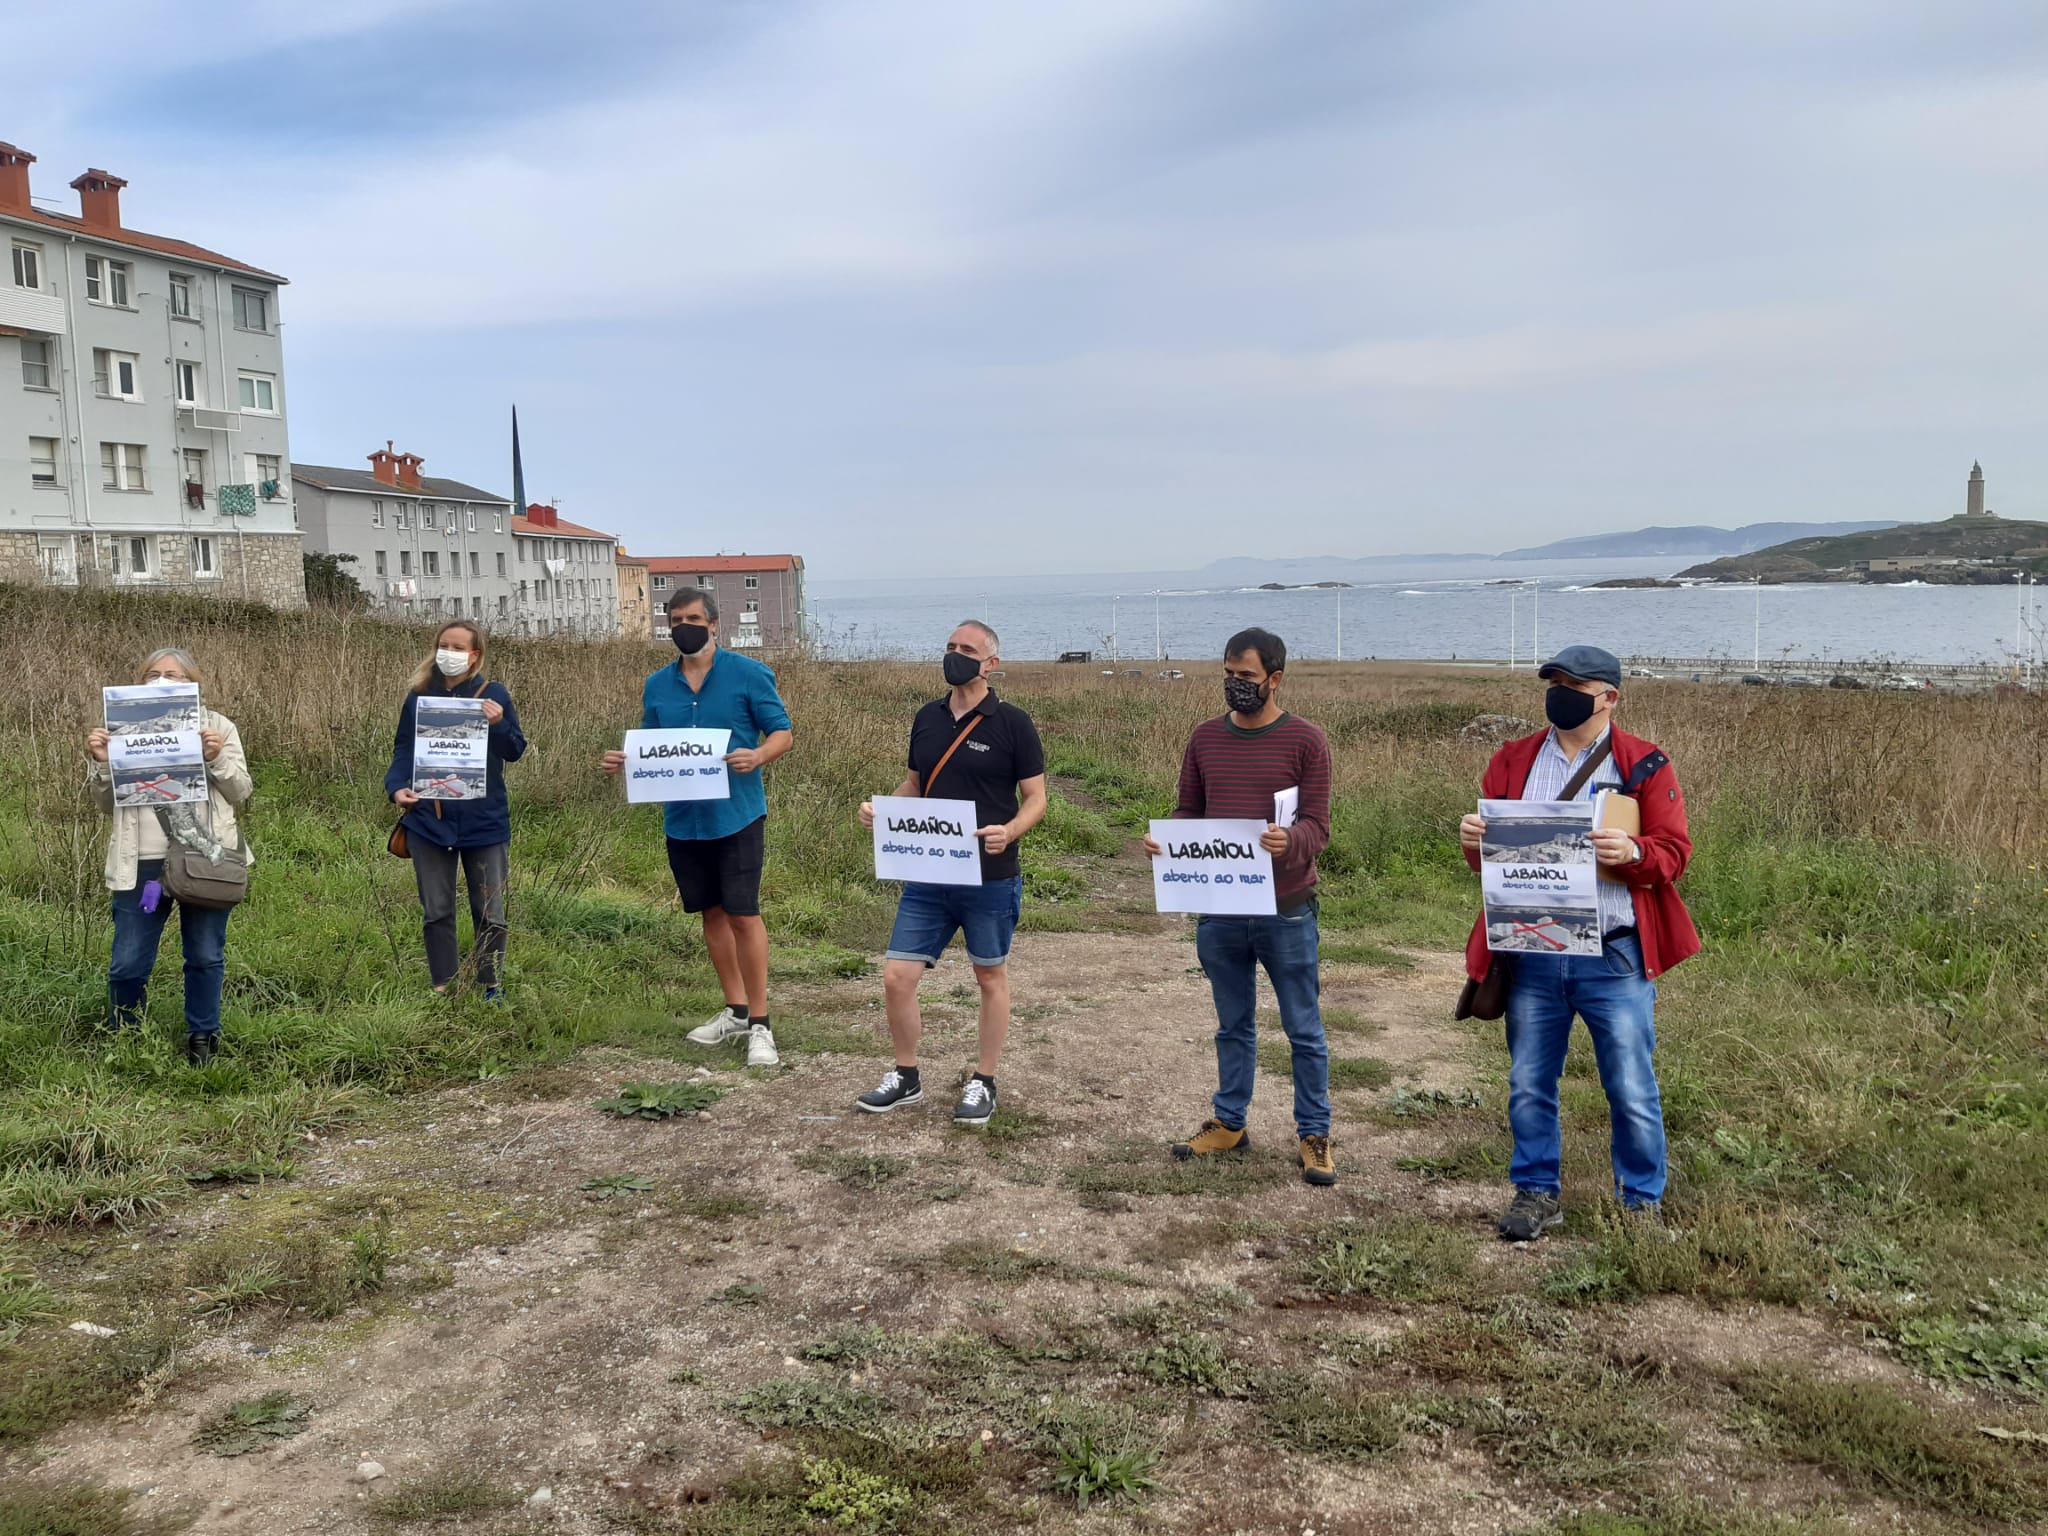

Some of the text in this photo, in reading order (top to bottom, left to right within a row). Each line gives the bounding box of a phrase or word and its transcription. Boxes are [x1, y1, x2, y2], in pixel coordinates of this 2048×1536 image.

[125, 735, 179, 747] LABAÑOU
[428, 740, 471, 750] LABAÑOU
[639, 741, 713, 760] LABAÑOU
[632, 767, 722, 779] aberto ao mar
[887, 816, 963, 837] LABAÑOU
[882, 840, 973, 859] aberto ao mar
[1168, 838, 1255, 860] LABAÑOU
[1162, 868, 1266, 884] aberto ao mar
[1502, 866, 1568, 881] LABAÑOU
[1502, 880, 1534, 890] aberto
